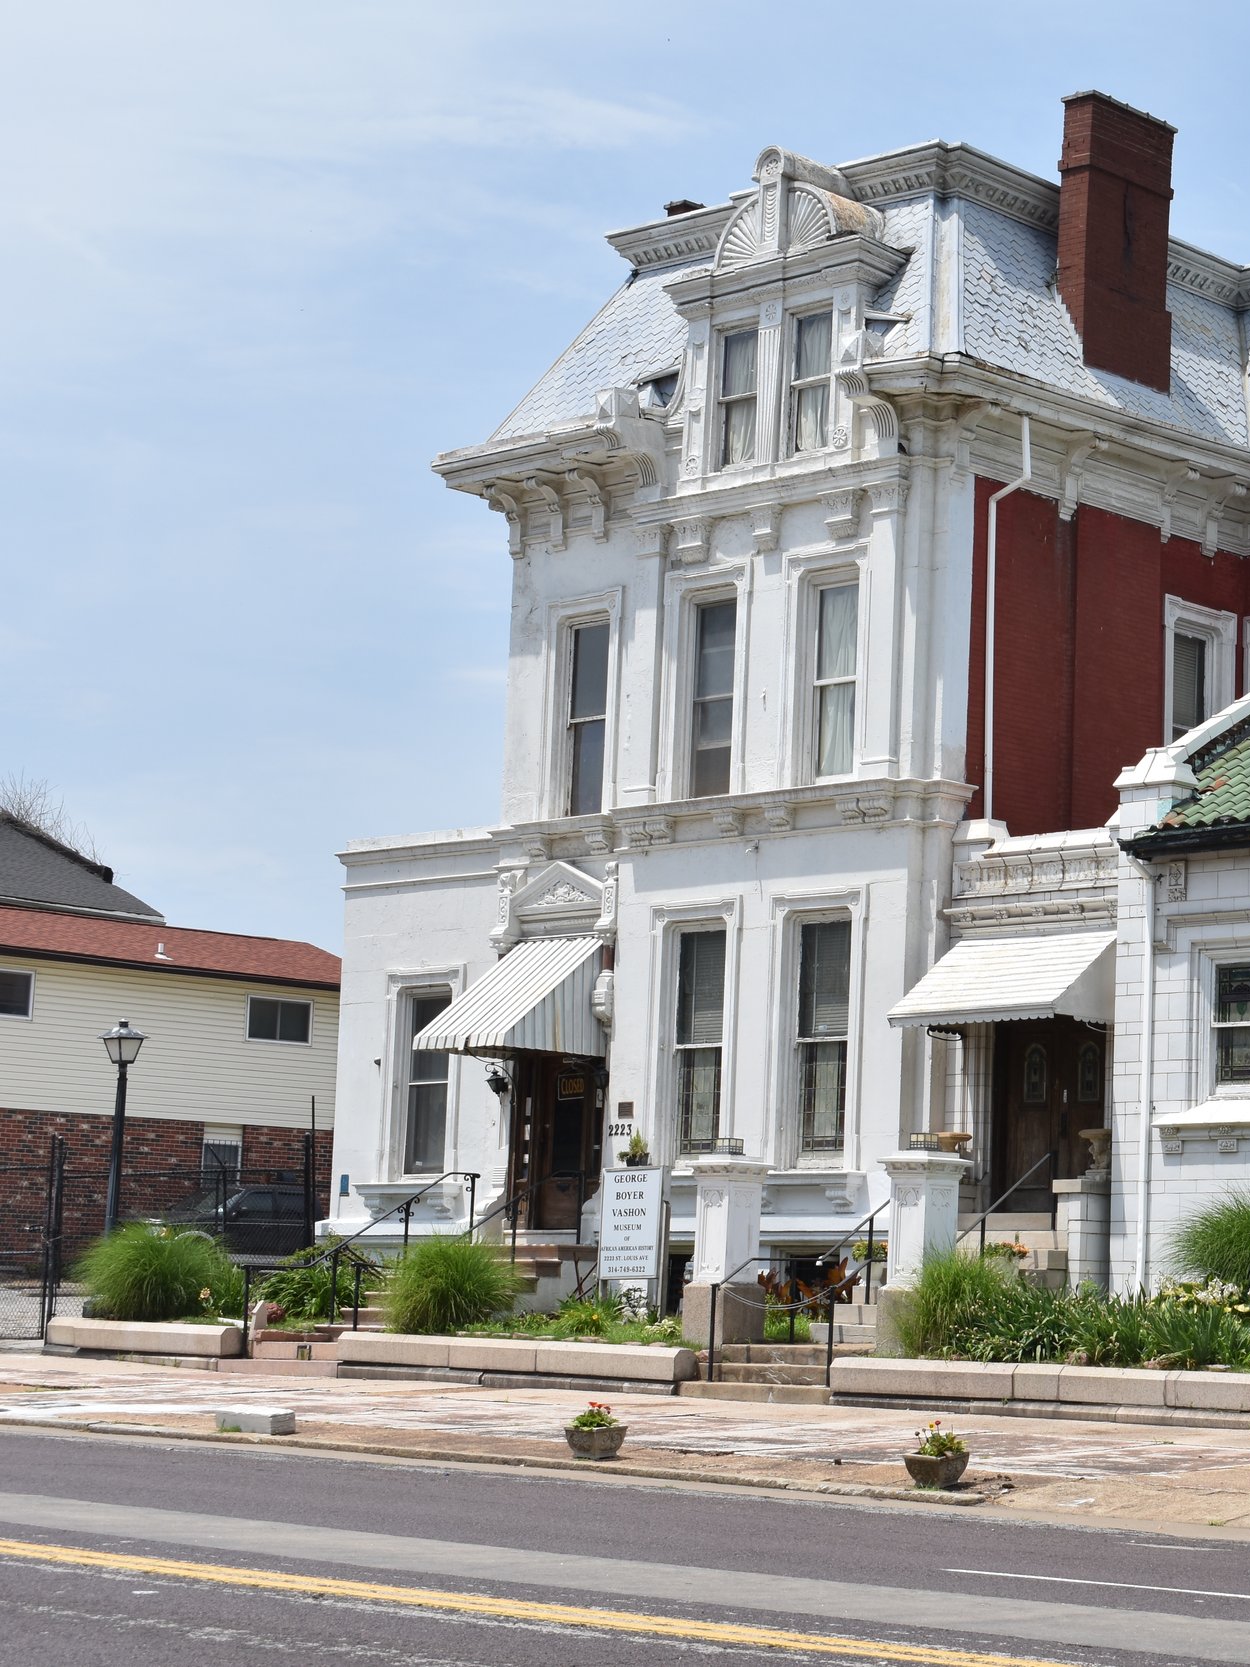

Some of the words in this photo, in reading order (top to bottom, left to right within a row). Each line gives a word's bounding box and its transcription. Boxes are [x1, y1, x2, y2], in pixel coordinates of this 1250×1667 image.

[561, 1078, 585, 1095] CLOSED
[608, 1123, 632, 1137] 2223
[614, 1174, 648, 1184] GEORGE
[616, 1191, 644, 1200] BOYER
[612, 1208, 647, 1217] VASHON
